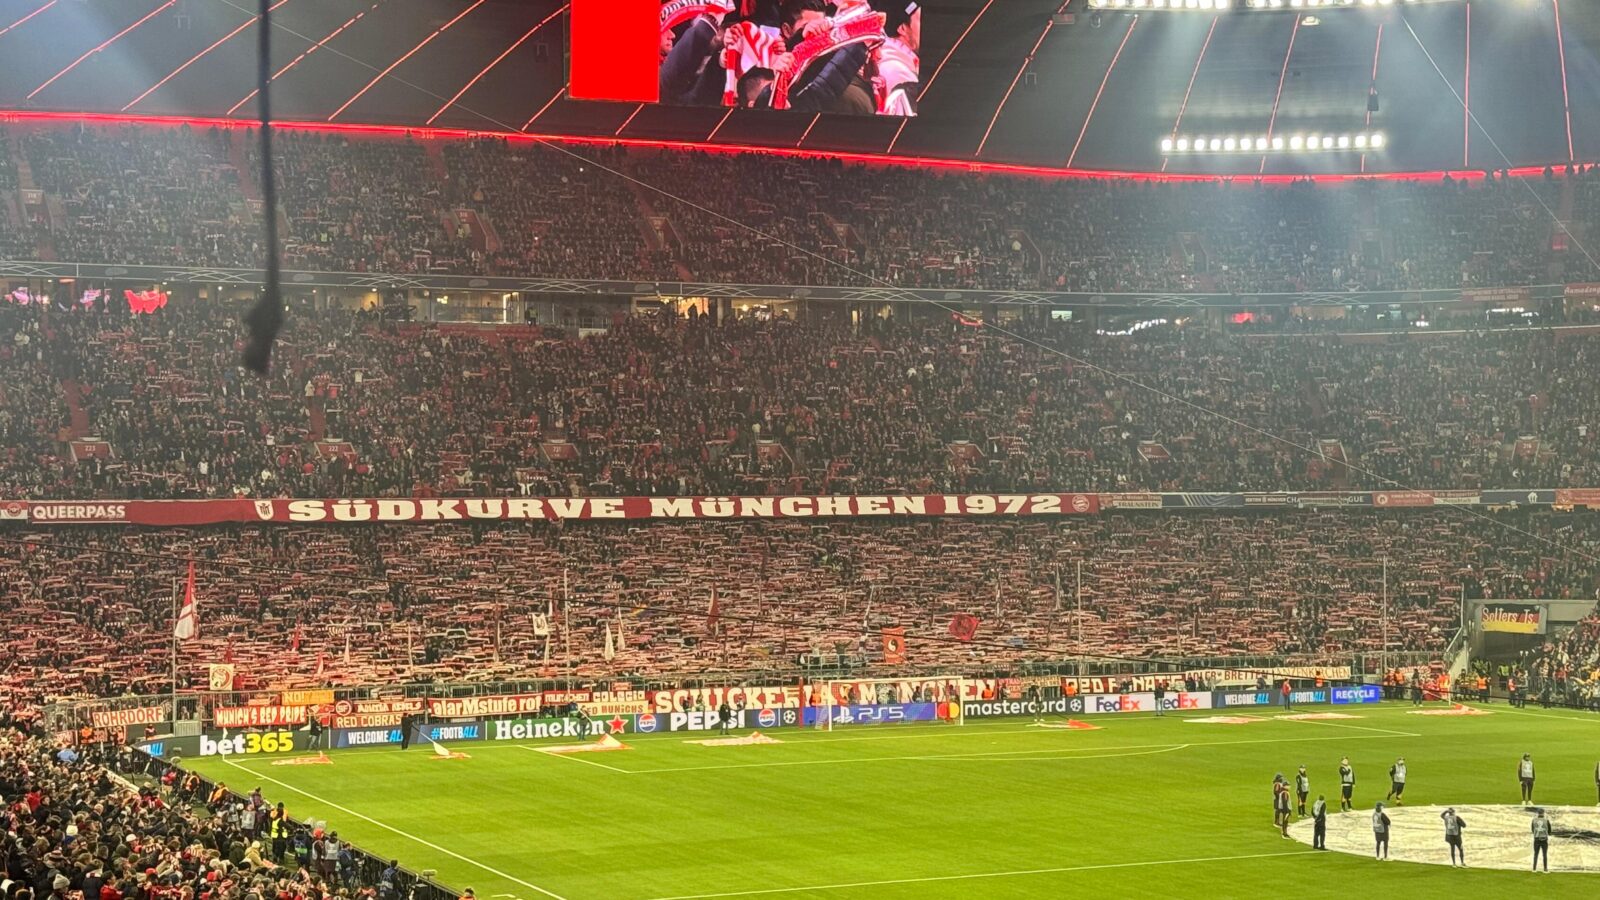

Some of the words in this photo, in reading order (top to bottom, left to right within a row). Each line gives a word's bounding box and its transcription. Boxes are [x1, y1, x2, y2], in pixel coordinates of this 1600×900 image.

[32, 504, 126, 520] QUEERPASS
[288, 498, 626, 522] SÜDKURVE
[650, 496, 926, 518] MÜNCHEN
[943, 495, 1062, 515] 1972
[858, 679, 996, 705] MNCHEN
[1163, 692, 1198, 709] edEx
[1225, 693, 1256, 705] WELCOME
[1335, 689, 1375, 699] RECYCLE
[964, 697, 1066, 716] mastercard
[1096, 694, 1140, 712] FedEx
[93, 707, 162, 727] ROHRDORF
[336, 716, 358, 729] RED
[361, 714, 402, 727] COBRAS
[670, 710, 745, 731] PEPSI
[858, 706, 904, 720] PS5
[431, 725, 479, 740] #FOOTBALL
[494, 717, 606, 740] Heineken
[200, 731, 294, 756] bet365
[348, 730, 389, 745] WELCOME
